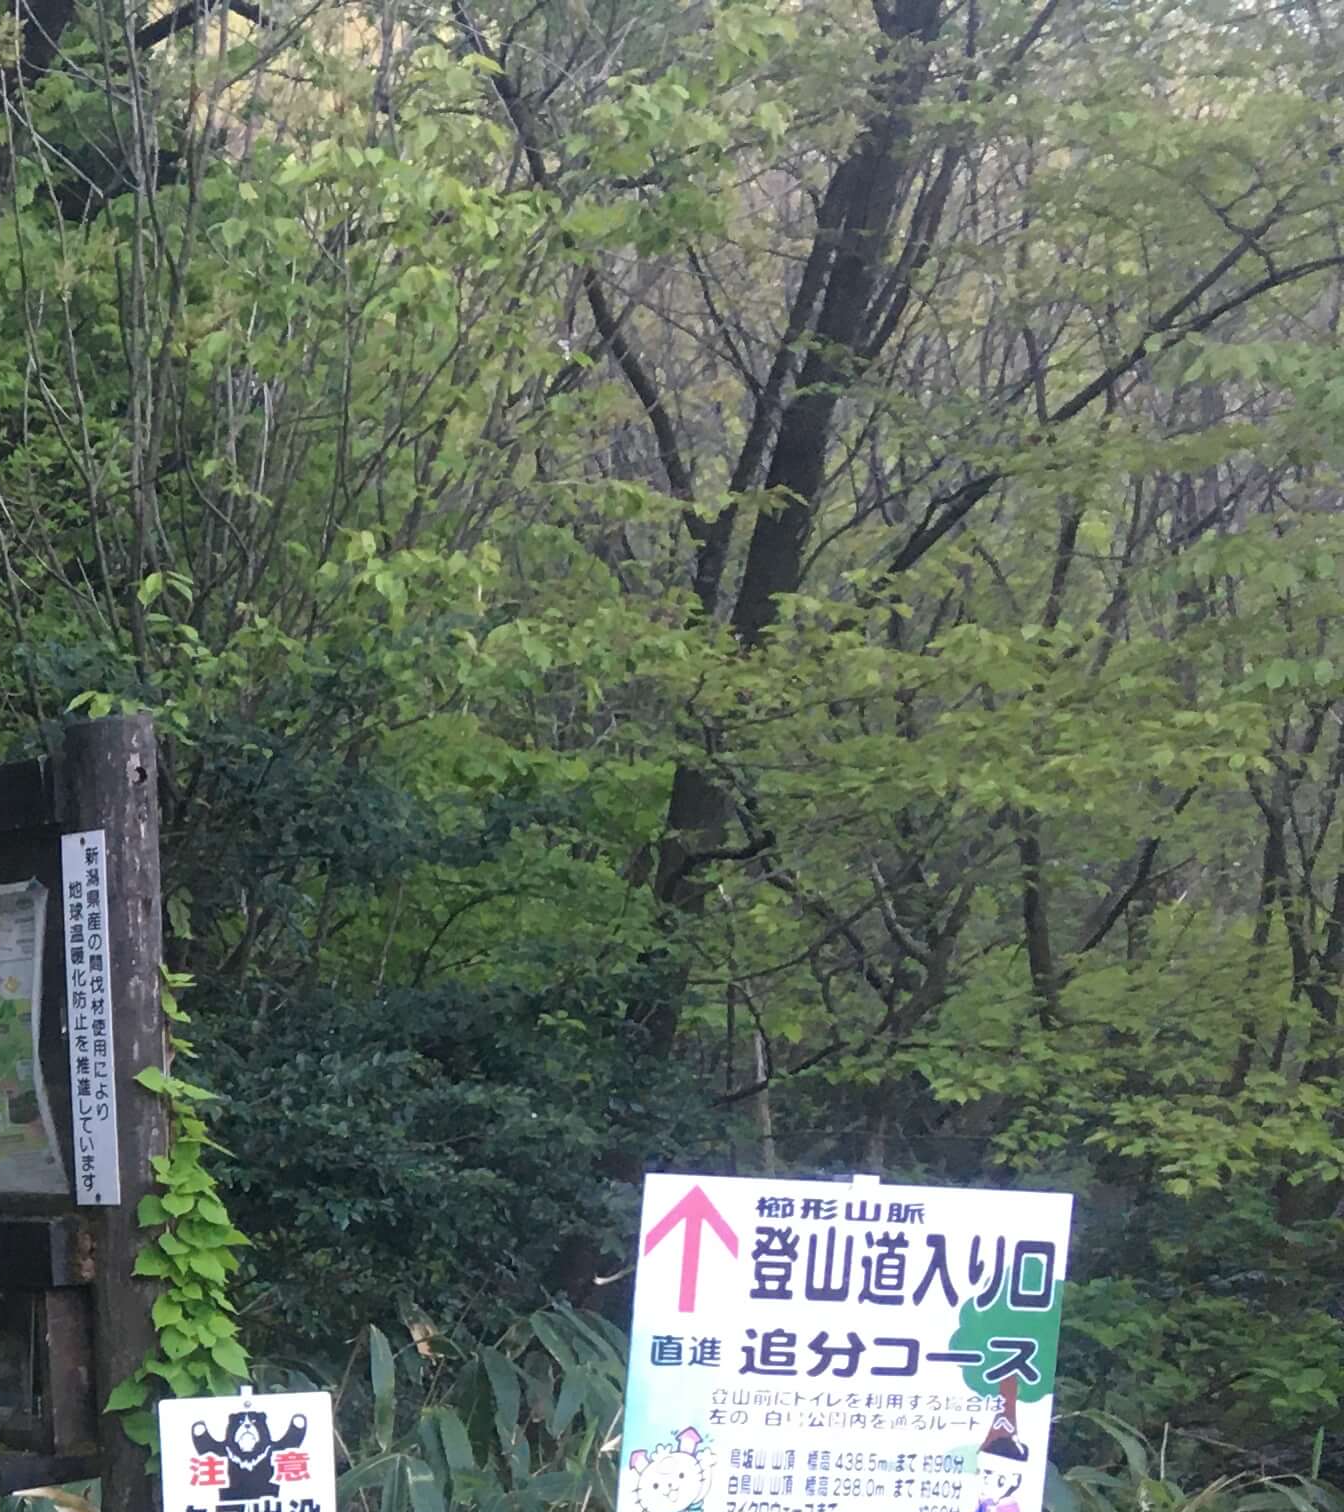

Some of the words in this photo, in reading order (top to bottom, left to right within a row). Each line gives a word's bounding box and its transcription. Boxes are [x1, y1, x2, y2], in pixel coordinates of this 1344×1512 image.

[85, 847, 109, 1121] 新潟県産の間伐材使用により
[68, 880, 96, 1192] 地球温暖化防止を推進しています
[755, 1196, 926, 1225] 櫛形山脈
[749, 1225, 1056, 1310] 登山道入り口
[650, 1335, 723, 1367] 直進
[738, 1328, 1042, 1385] 追分コース
